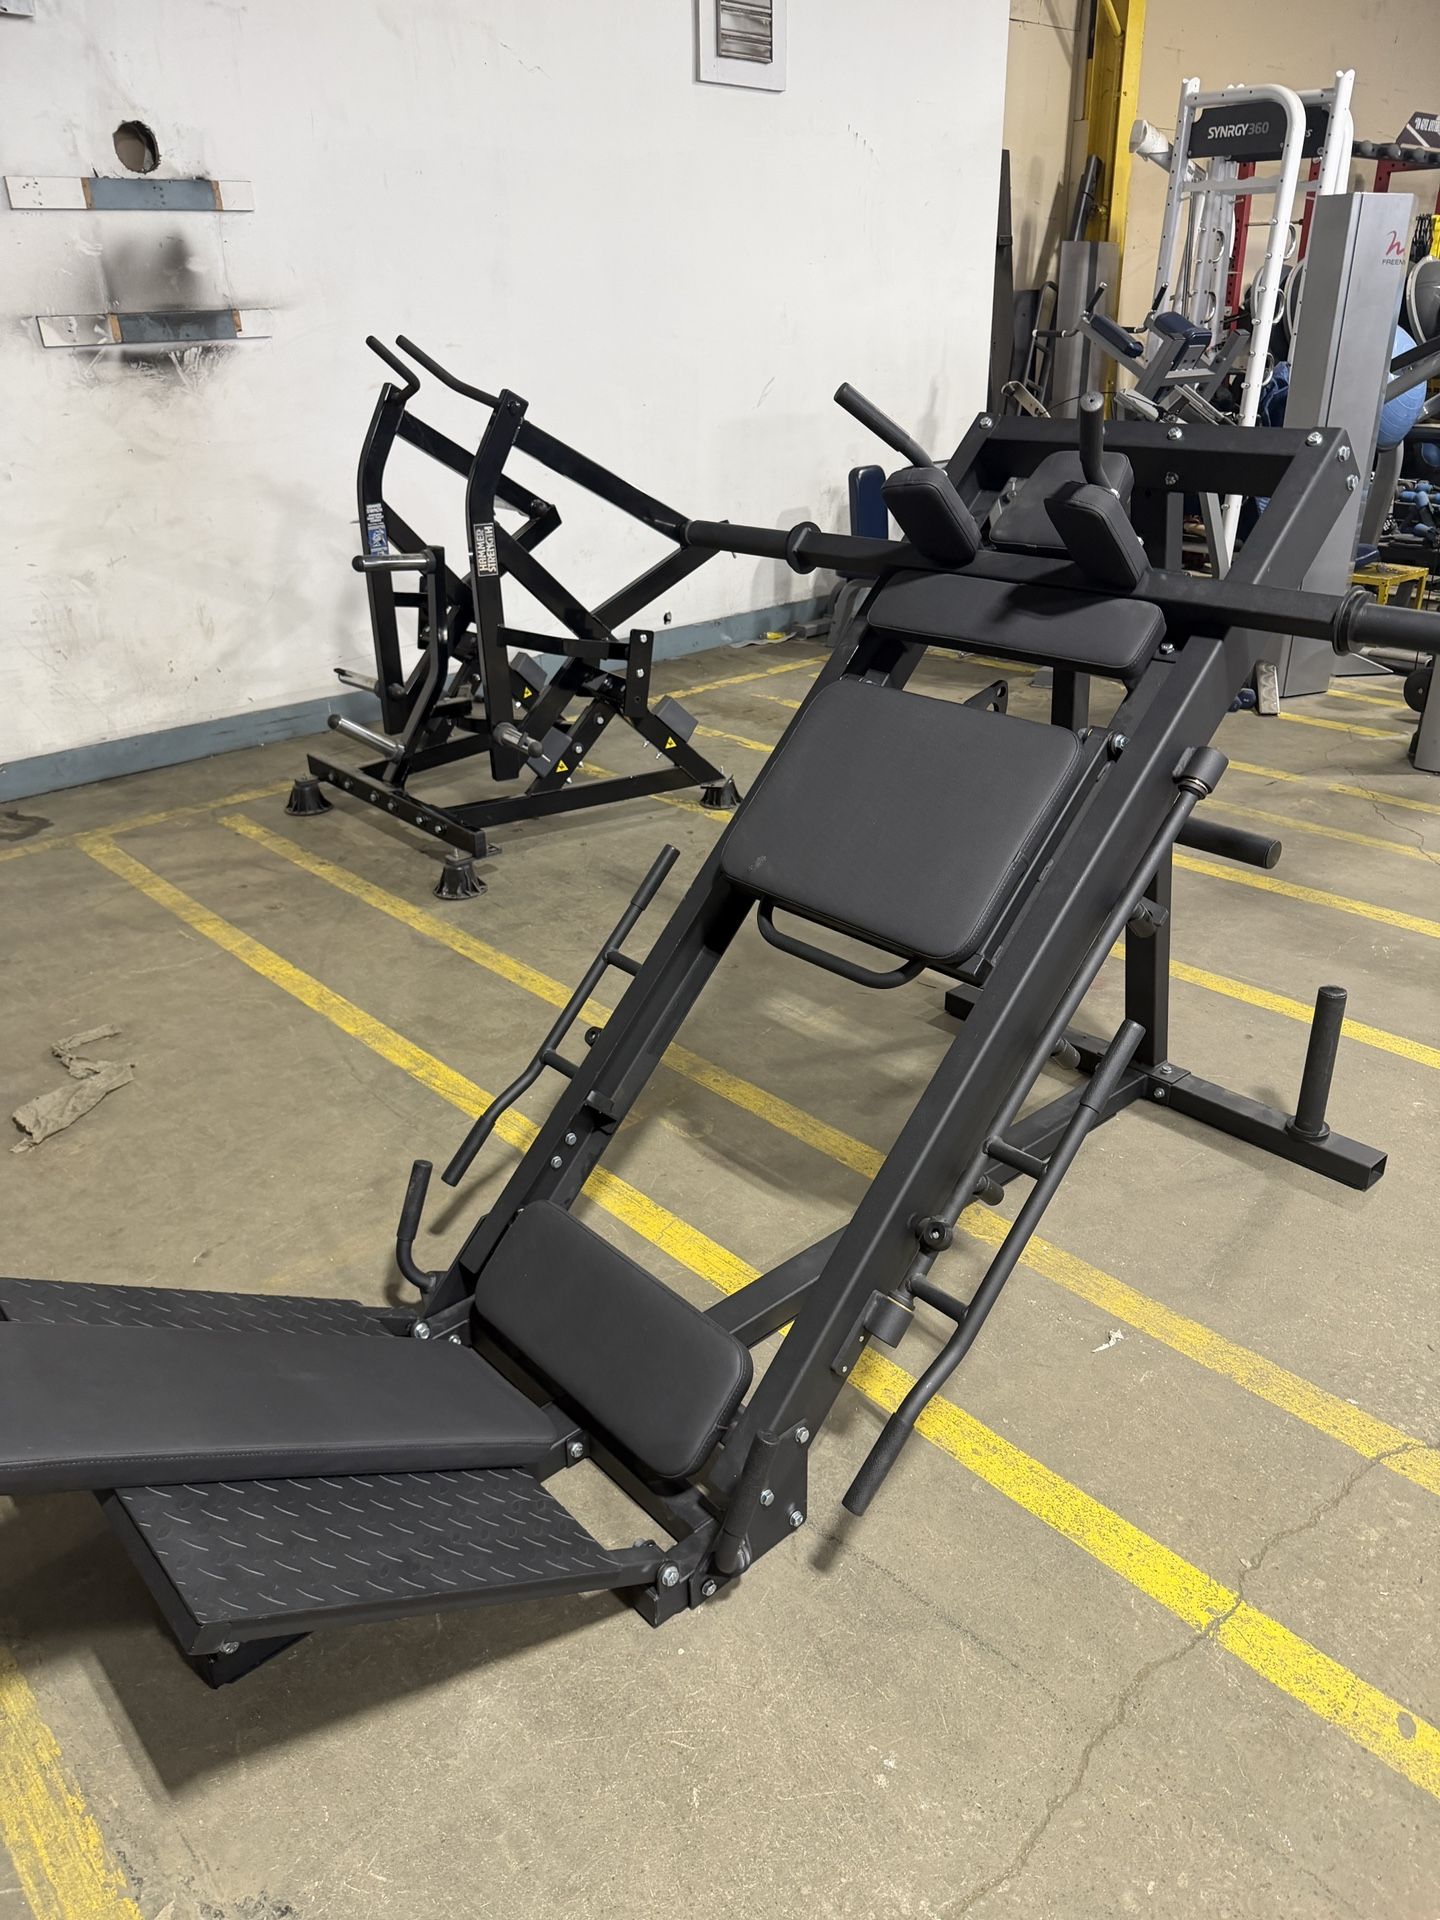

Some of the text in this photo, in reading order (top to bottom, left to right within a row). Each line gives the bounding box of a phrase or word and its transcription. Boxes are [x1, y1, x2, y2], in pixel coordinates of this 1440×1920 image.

[1207, 121, 1270, 140] SYNRGY360
[476, 528, 488, 571] HAMMER
[484, 526, 497, 572] STRENGTH
